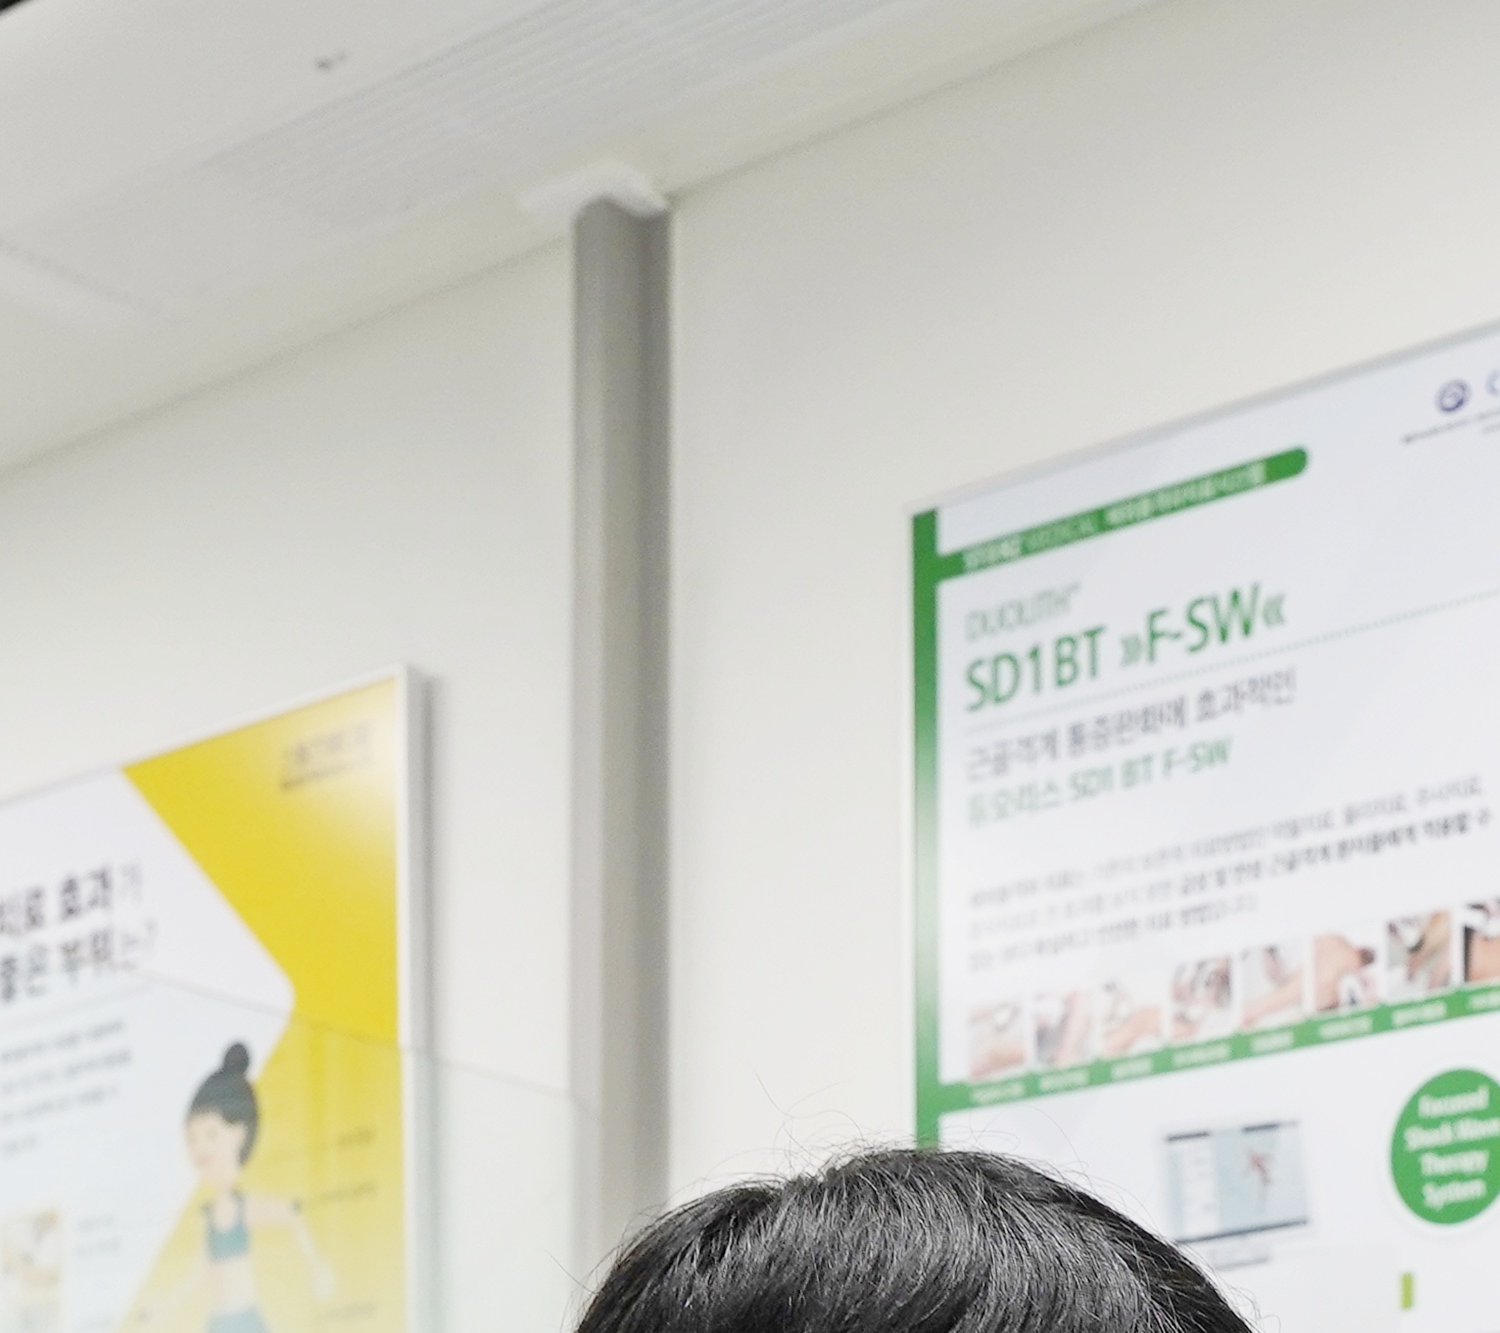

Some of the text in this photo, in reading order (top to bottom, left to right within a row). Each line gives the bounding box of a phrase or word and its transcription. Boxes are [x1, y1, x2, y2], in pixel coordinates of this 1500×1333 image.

[965, 644, 1043, 713] SD1
[1054, 624, 1107, 689] BT
[1197, 664, 1297, 723] 효과적인
